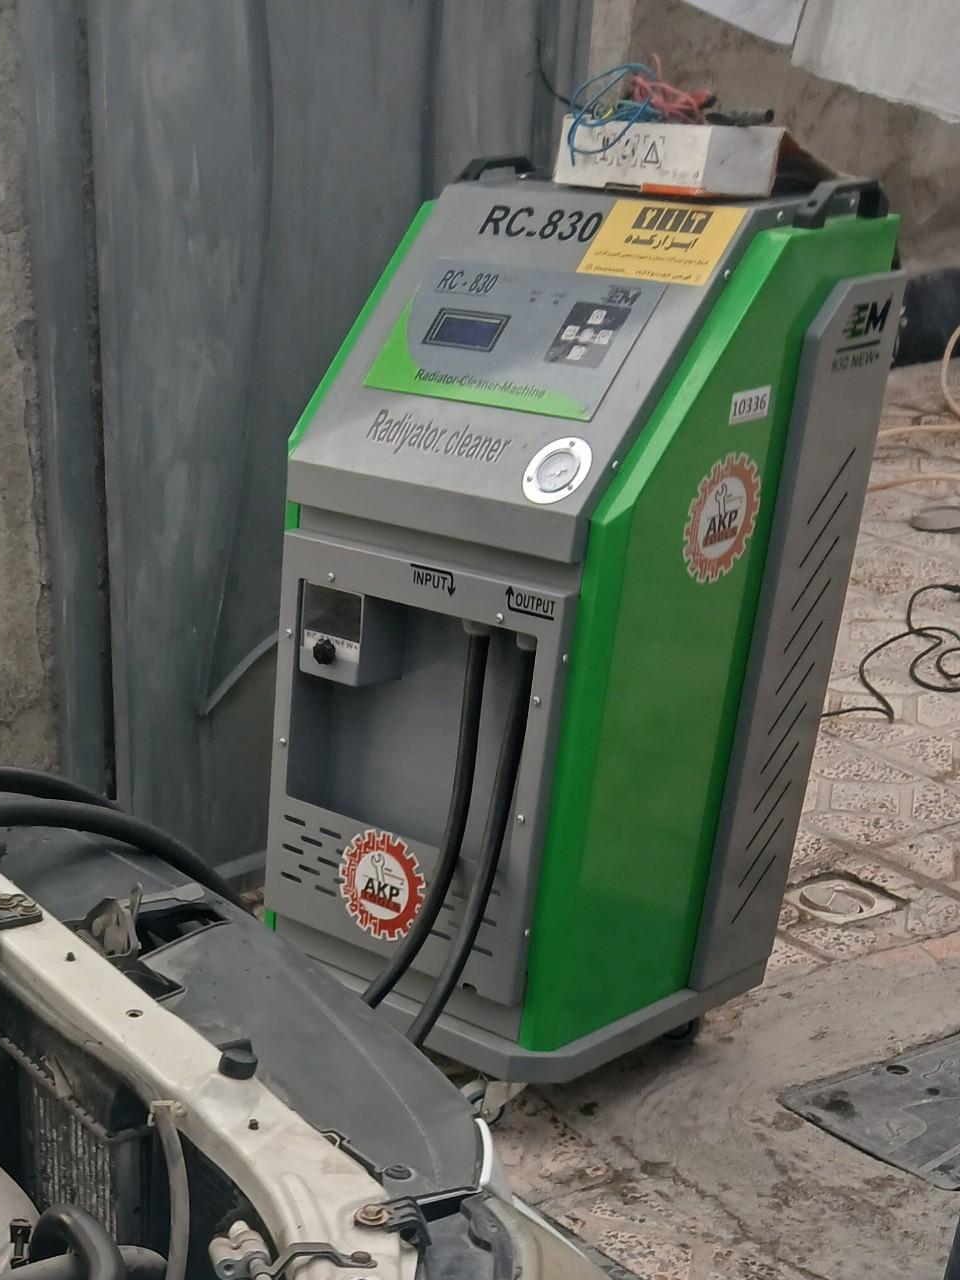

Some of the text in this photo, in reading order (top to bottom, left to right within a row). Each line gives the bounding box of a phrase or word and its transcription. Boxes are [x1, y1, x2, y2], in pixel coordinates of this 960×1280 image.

[732, 395, 767, 417] 10336
[706, 509, 738, 537] AKP
[413, 570, 448, 590] INPUT
[515, 592, 556, 615] OUTPUT
[363, 878, 400, 902] AKP
